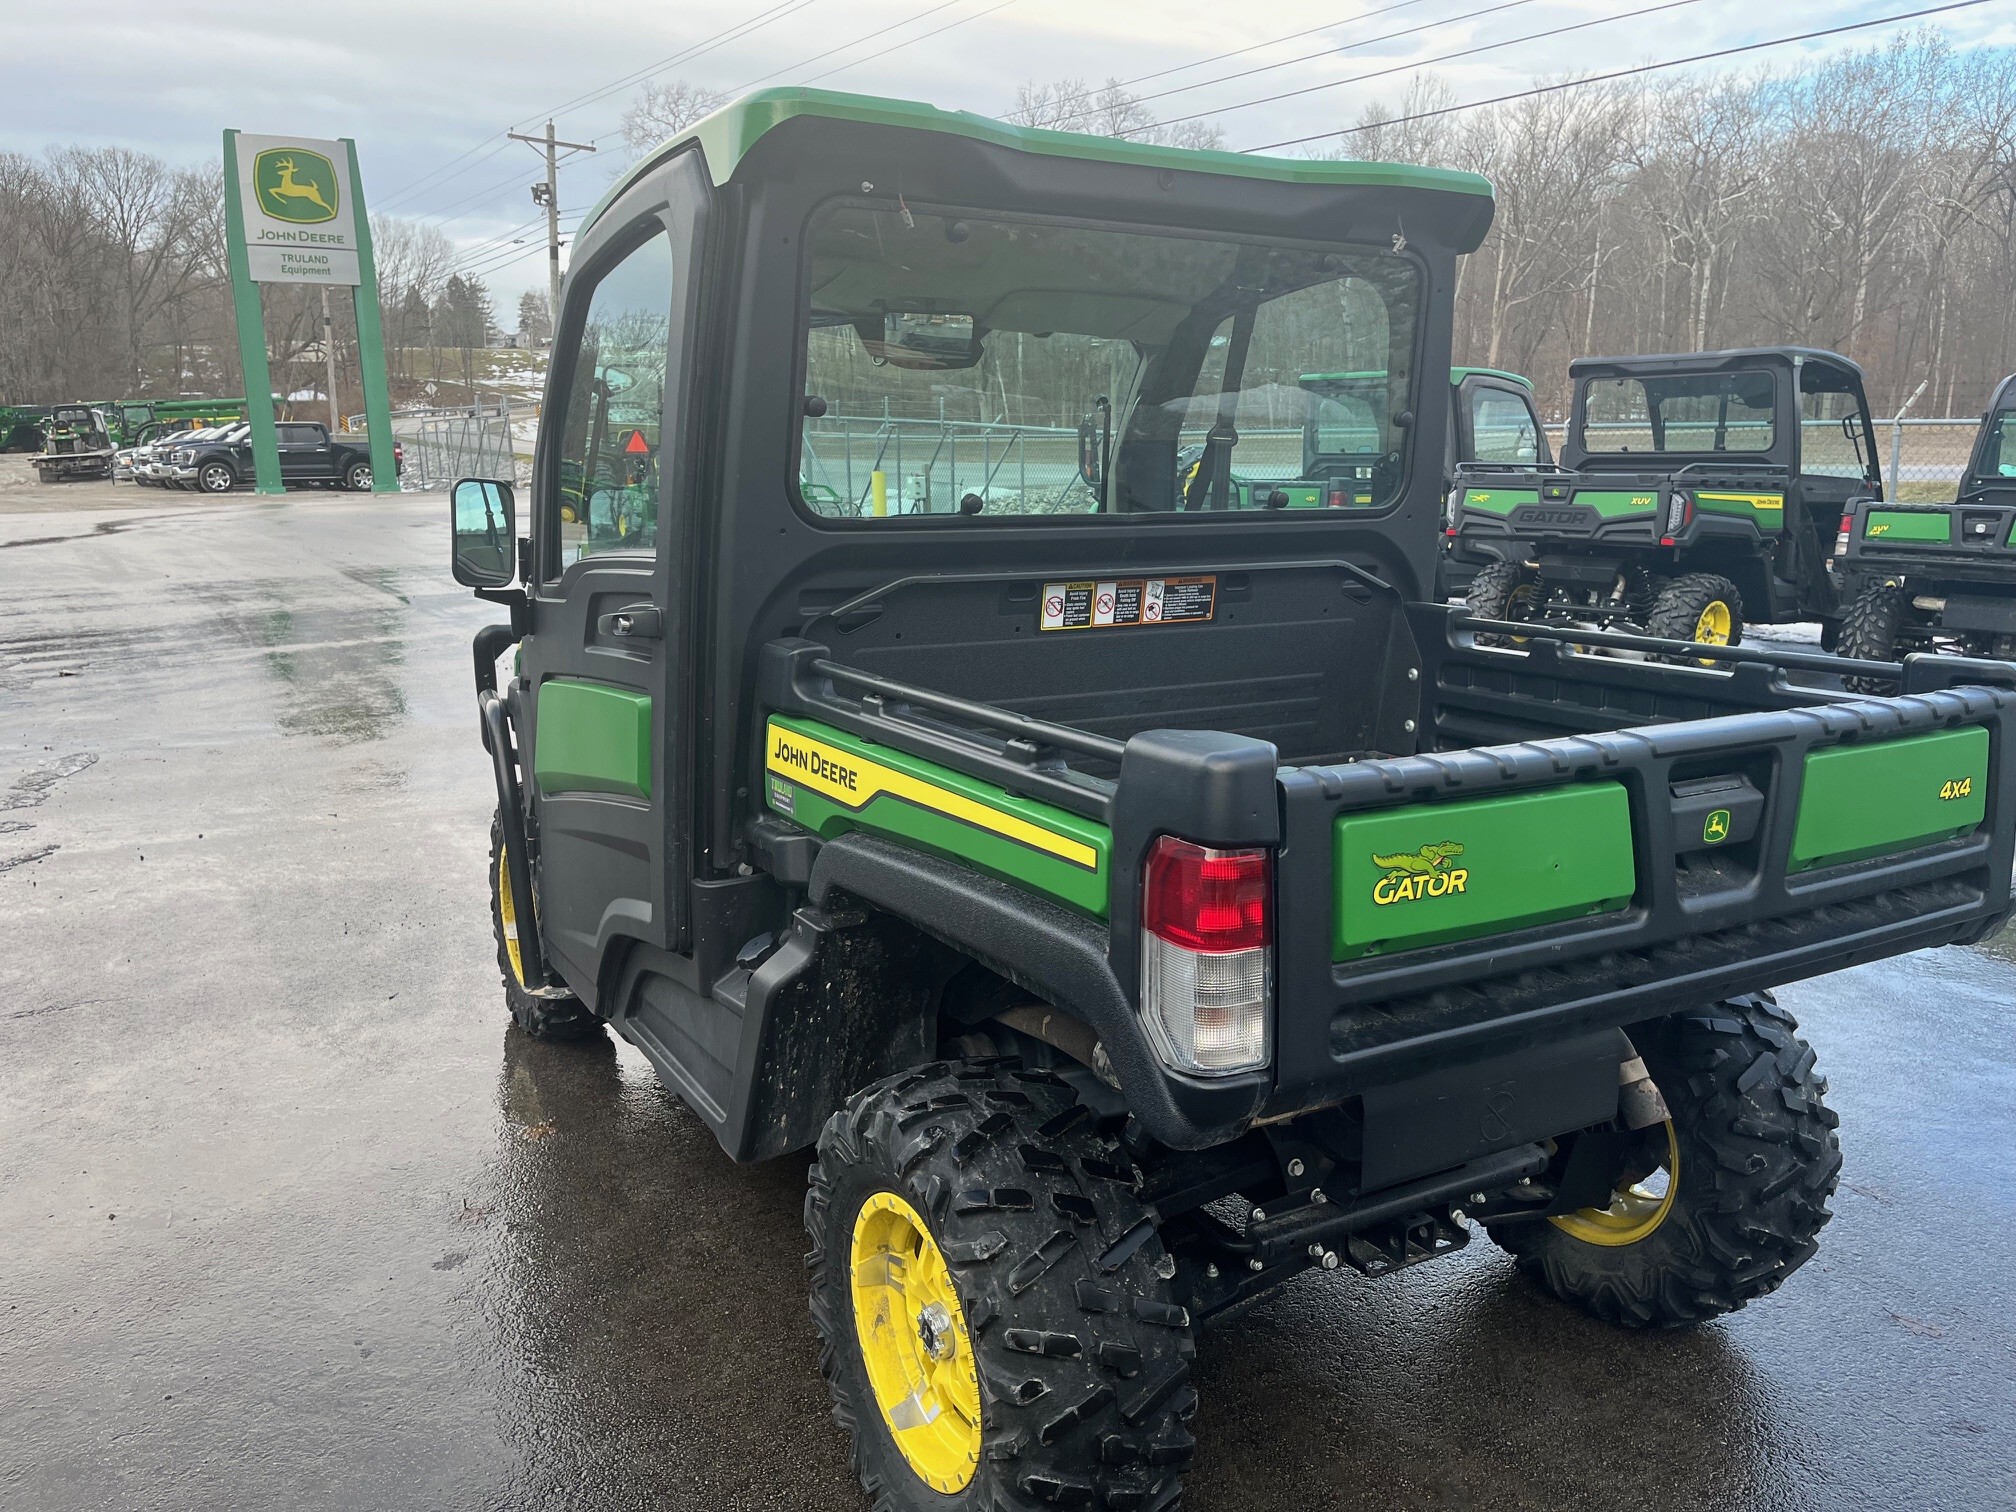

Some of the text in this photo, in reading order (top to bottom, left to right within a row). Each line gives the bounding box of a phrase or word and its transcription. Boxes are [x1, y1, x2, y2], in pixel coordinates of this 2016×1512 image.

[257, 228, 345, 244] JOHN DEERE
[281, 253, 329, 264] TRULAND
[281, 264, 331, 276] Equipment
[1630, 497, 1652, 505] XUV
[1519, 510, 1588, 525] GATOR
[1872, 524, 1890, 532] XUV
[774, 737, 858, 792] JOHN DEERE
[1372, 868, 1468, 906] GATOR
